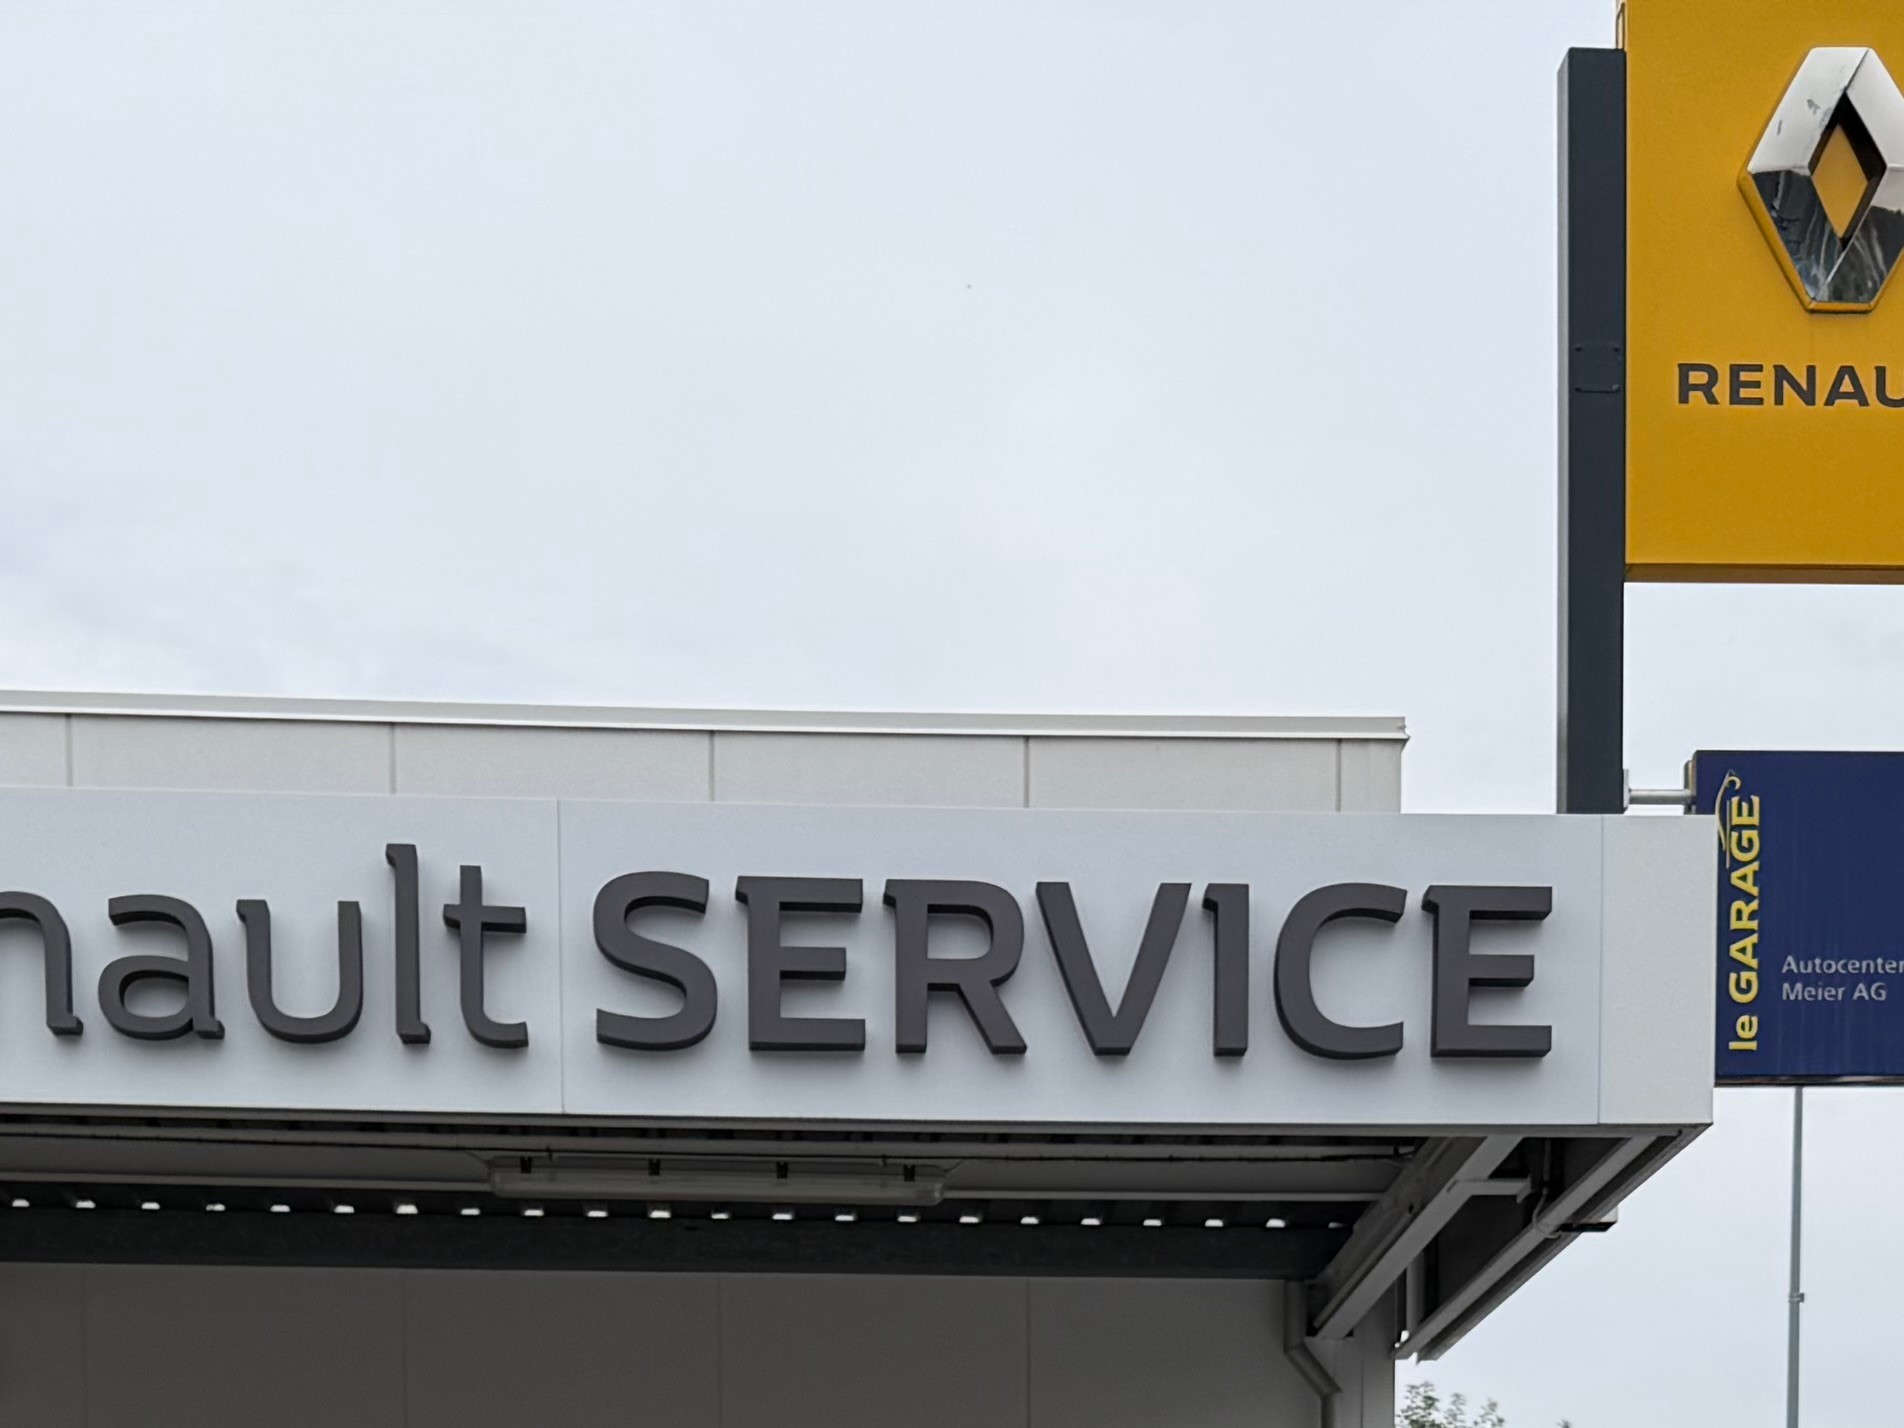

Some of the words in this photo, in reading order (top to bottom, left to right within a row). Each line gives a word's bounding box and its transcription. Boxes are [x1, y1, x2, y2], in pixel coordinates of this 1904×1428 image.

[1730, 795, 1760, 1004] GARAGE
[593, 871, 1553, 1060] SERVICE
[1781, 981, 1846, 1003] Meier
[1853, 982, 1888, 1003] AG
[1729, 1014, 1758, 1051] le
